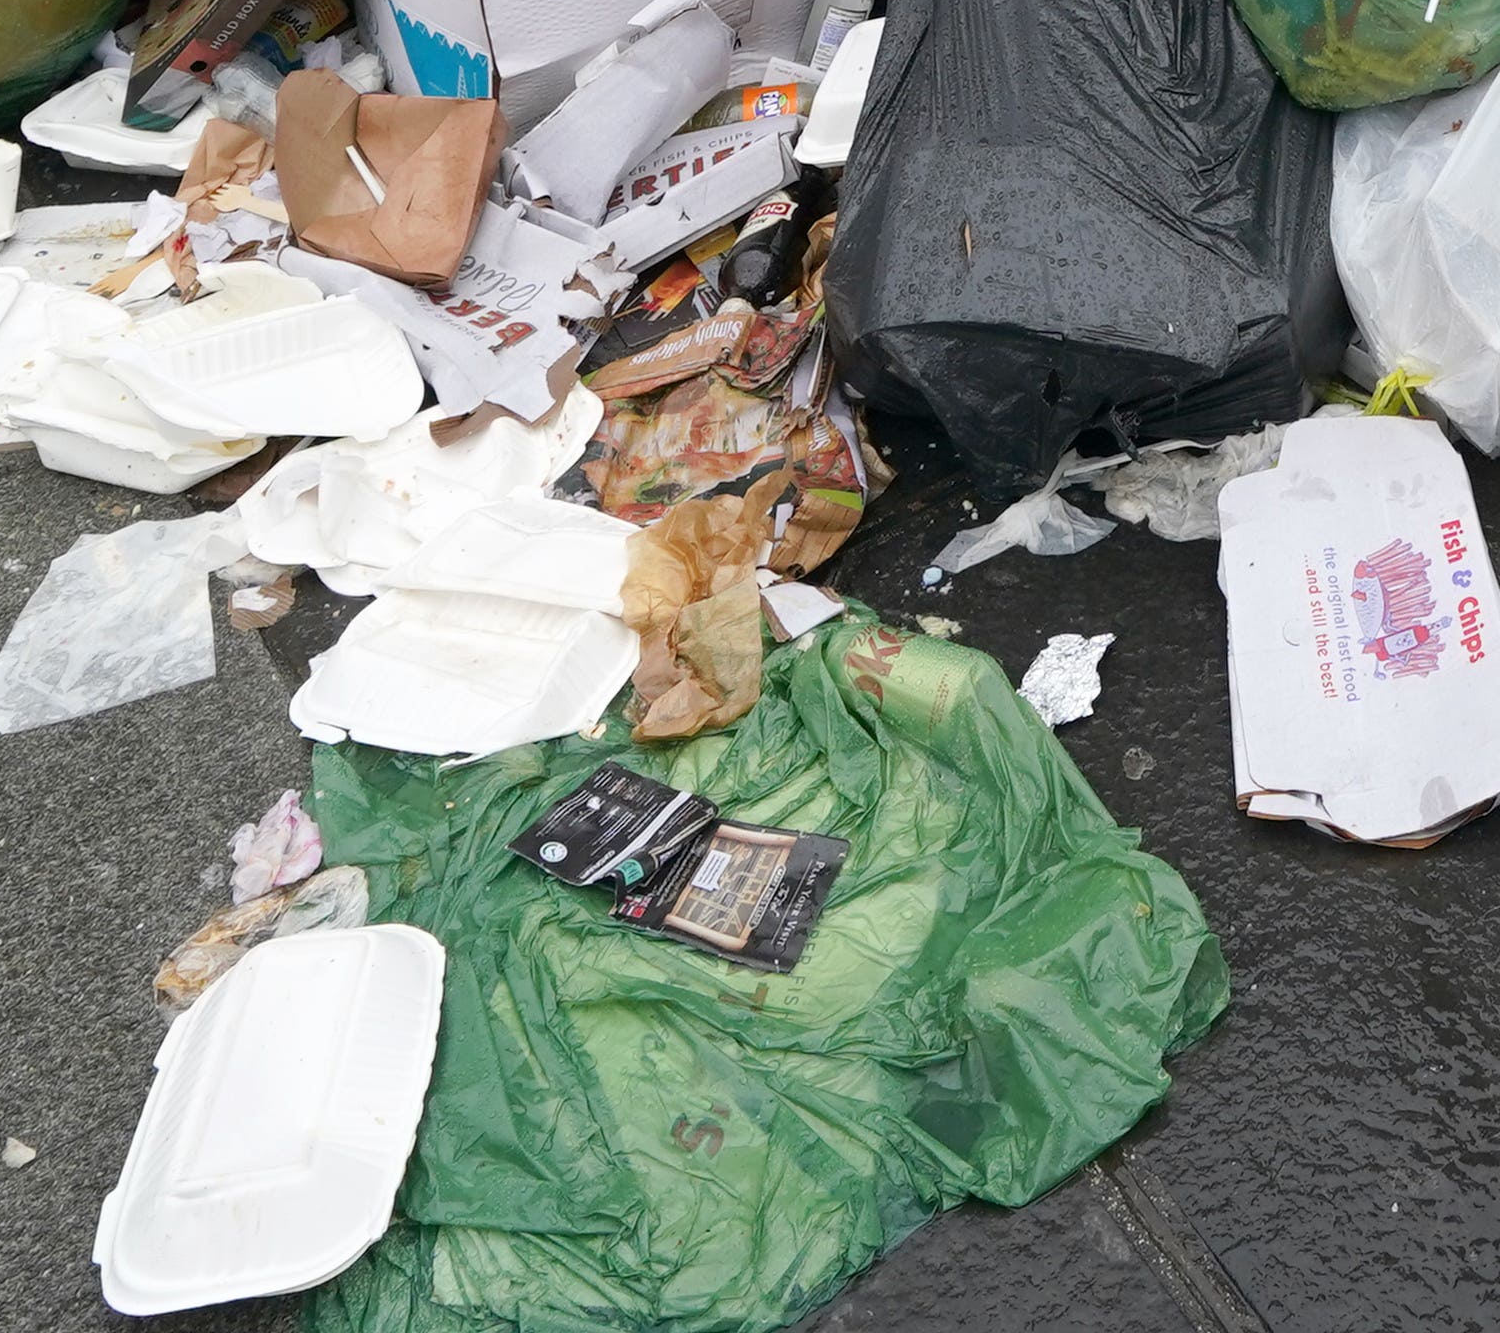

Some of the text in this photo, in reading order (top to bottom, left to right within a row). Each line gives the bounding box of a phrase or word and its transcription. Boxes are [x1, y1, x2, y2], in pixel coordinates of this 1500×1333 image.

[209, 19, 239, 50] HOLD
[652, 149, 687, 169] FISH
[708, 131, 753, 149] CHIPS
[693, 319, 742, 343] Simply
[1440, 519, 1485, 664] Fish & Chips
[1310, 601, 1328, 628] still
[1323, 546, 1361, 702] the original fast food
[1314, 633, 1329, 658] the
[1319, 663, 1339, 700] best!
